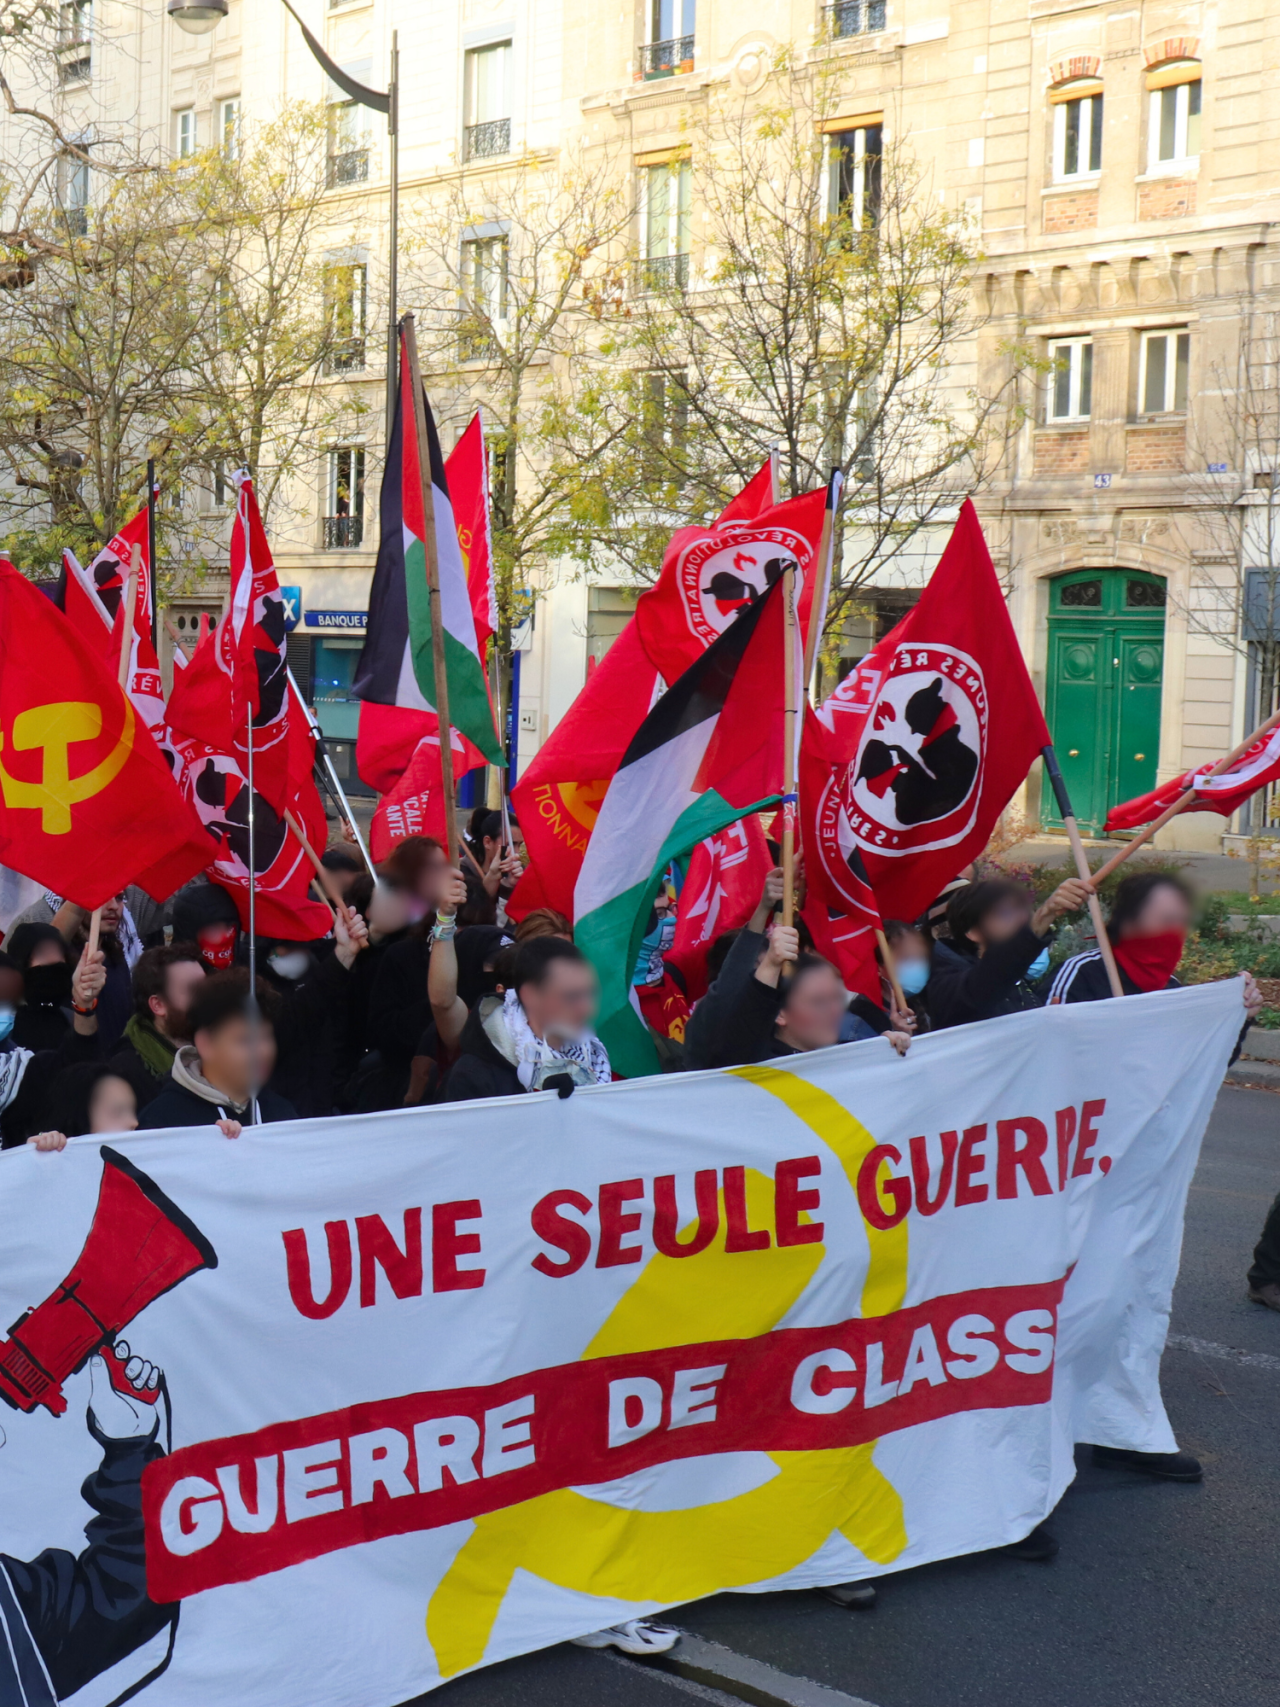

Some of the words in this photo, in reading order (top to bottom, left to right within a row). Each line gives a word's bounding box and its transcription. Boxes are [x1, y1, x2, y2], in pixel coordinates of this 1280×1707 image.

[1095, 475, 1110, 488] 43
[318, 614, 361, 627] BANQUE
[281, 1198, 485, 1320] UNE
[530, 1155, 825, 1279] SEULE
[160, 1394, 537, 1557] GUERRE
[606, 1363, 729, 1448] DE
[789, 1308, 1055, 1415] CLASS
